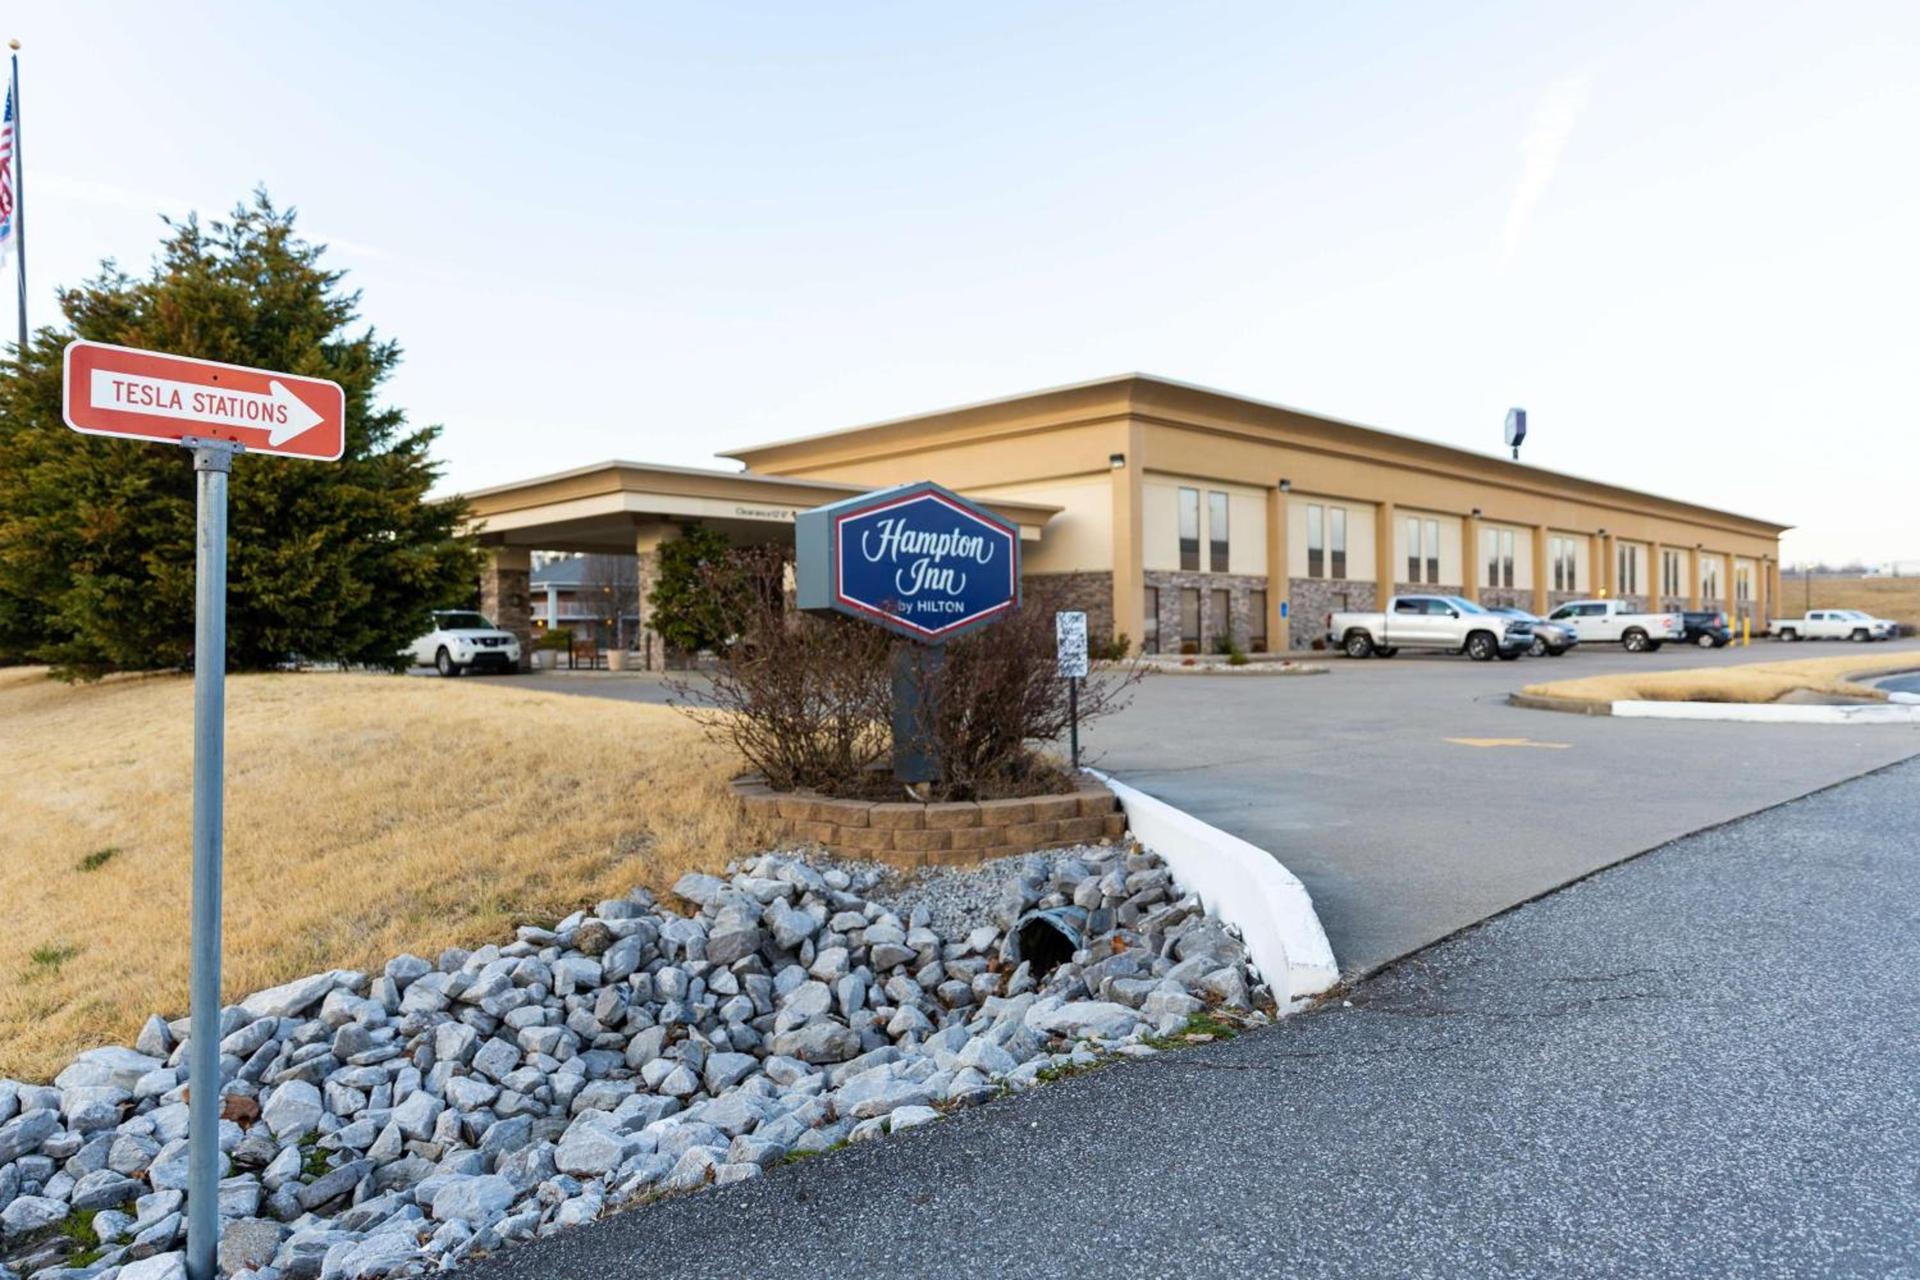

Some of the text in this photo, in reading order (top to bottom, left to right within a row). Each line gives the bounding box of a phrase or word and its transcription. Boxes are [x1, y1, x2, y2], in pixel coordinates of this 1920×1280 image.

[112, 380, 288, 424] TESLA STATIONS
[862, 518, 994, 564] Hampton
[896, 558, 966, 595] Inn
[898, 600, 965, 614] by HILTON
